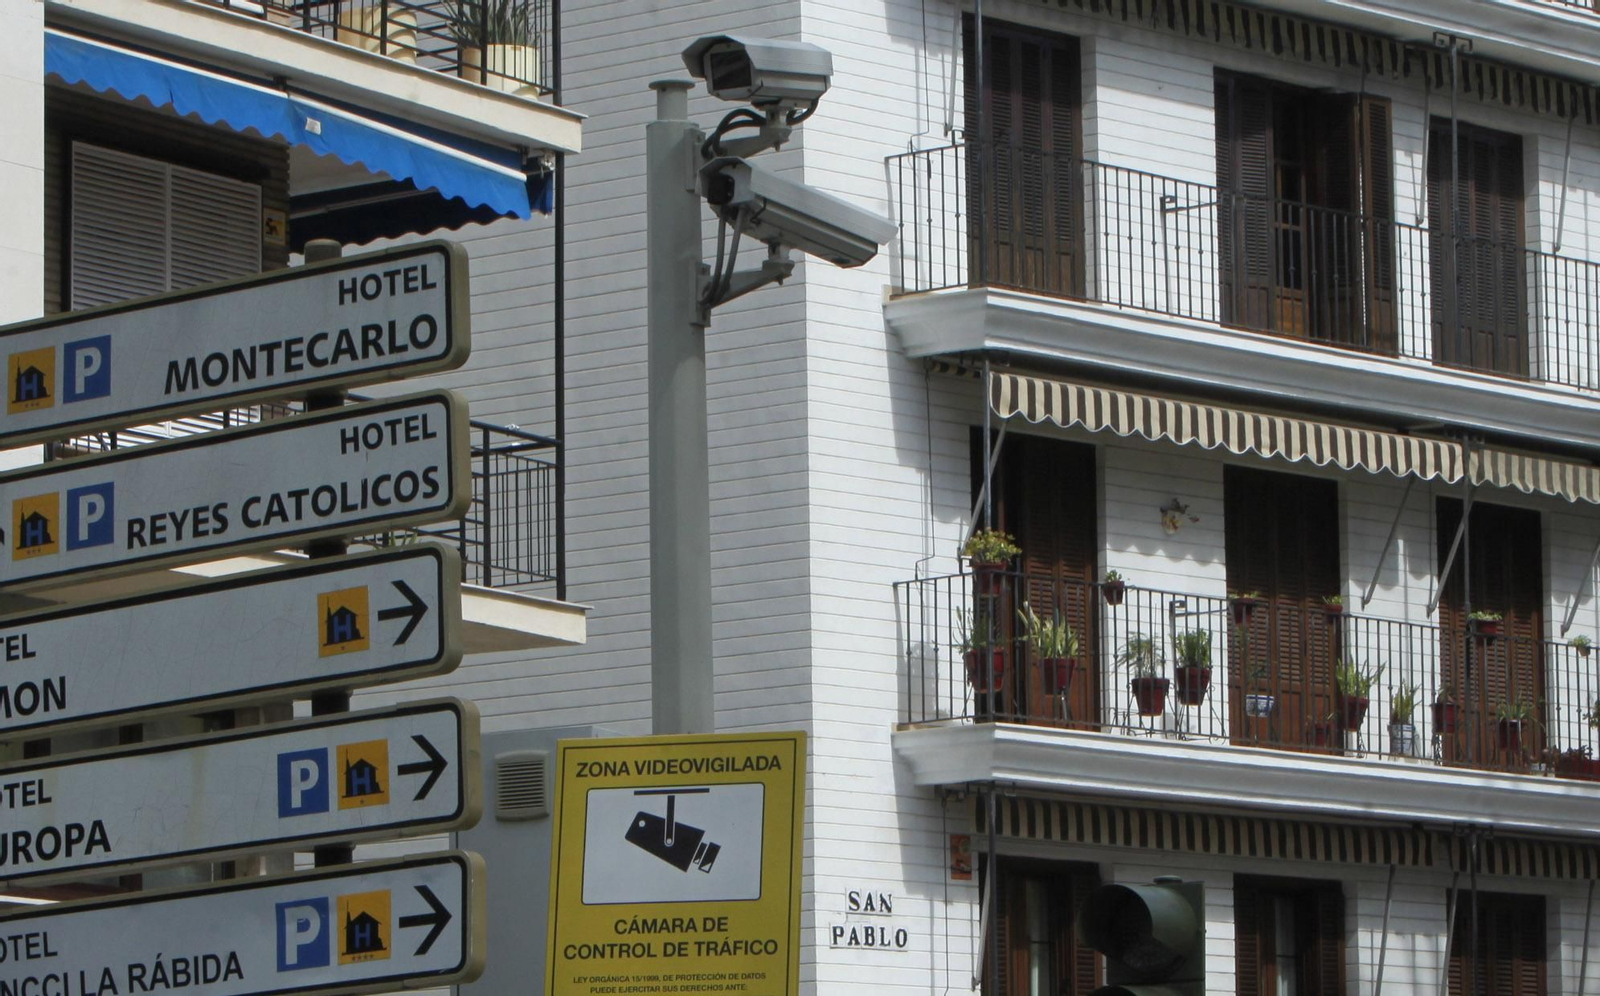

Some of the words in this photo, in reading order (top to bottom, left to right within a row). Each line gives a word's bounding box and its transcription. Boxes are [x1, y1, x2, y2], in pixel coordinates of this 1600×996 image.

[338, 264, 437, 305] HOTEL
[75, 345, 102, 395] P
[164, 313, 438, 395] MONTECARLO
[340, 413, 437, 454] HOTEL
[79, 493, 105, 541] P
[127, 502, 229, 550] REYES
[241, 465, 440, 527] CATOLICOS
[290, 759, 319, 808] P
[575, 761, 630, 778] ZONA
[634, 755, 782, 776] VIDEOVIGILADA
[0, 778, 52, 809] TEL
[848, 891, 892, 913] SAN
[284, 905, 320, 965] P
[614, 918, 696, 935] CÁMARA
[702, 916, 729, 932] DE
[831, 924, 909, 949] PABLO
[563, 943, 658, 961] CONTROL
[664, 942, 690, 957] DE
[695, 936, 779, 956] TRÁFICO
[80, 967, 119, 996] LA
[127, 952, 244, 994] RÁBIDA
[589, 974, 630, 983] ORGÁNICA
[676, 972, 726, 980] PROTECCIÓN
[741, 972, 766, 980] DATOS
[619, 985, 660, 993] EJERCITAR
[680, 983, 723, 992] DERECHOS
[725, 983, 748, 991] ANTE:
